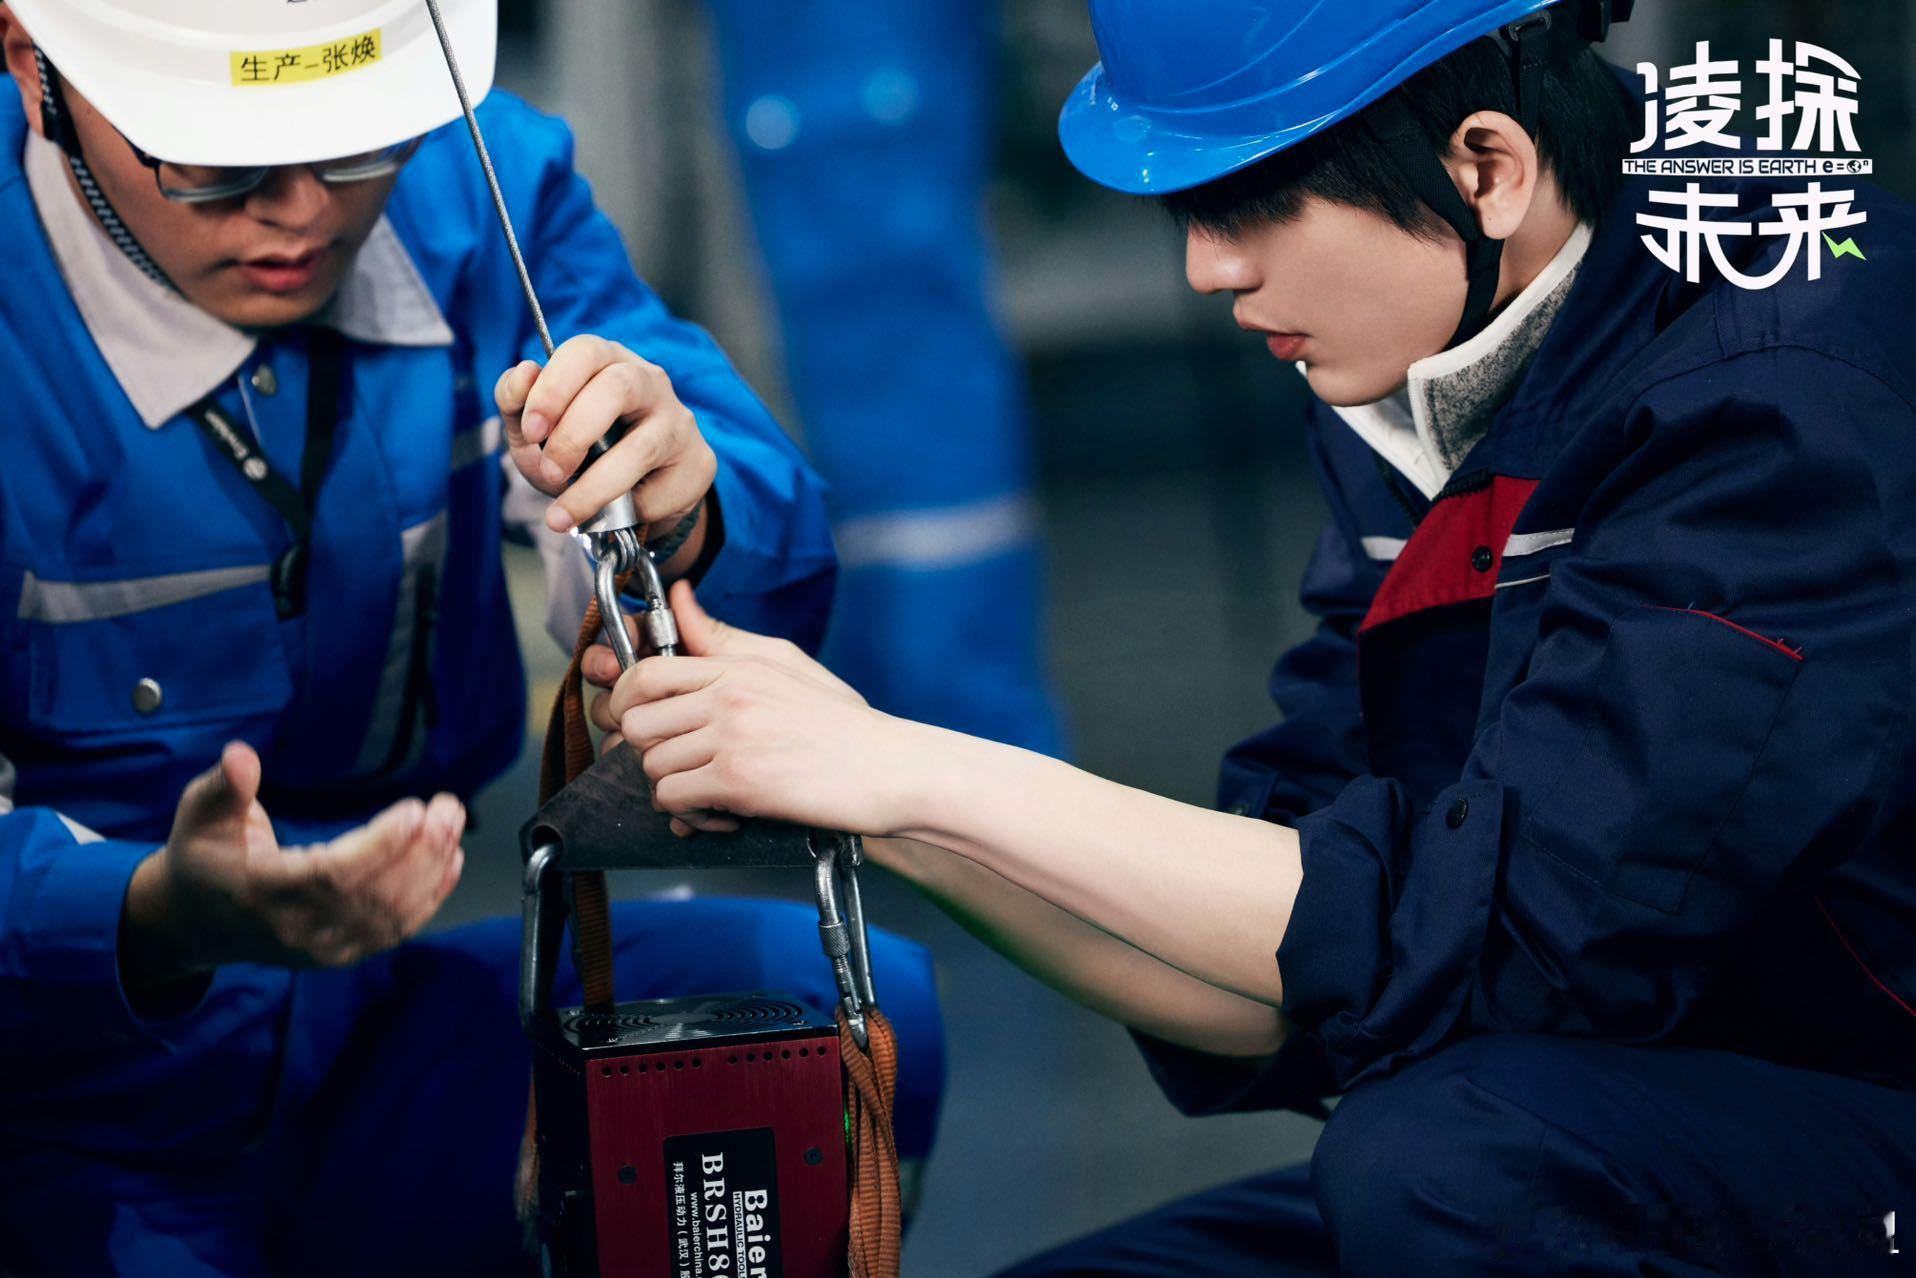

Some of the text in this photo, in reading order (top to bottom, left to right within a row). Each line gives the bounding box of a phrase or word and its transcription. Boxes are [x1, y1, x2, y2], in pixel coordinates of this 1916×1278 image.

[690, 1192, 704, 1278] www.baierchina.
[734, 1192, 747, 1278] HYDRAULIC TOOL
[744, 1189, 771, 1278] Baier
